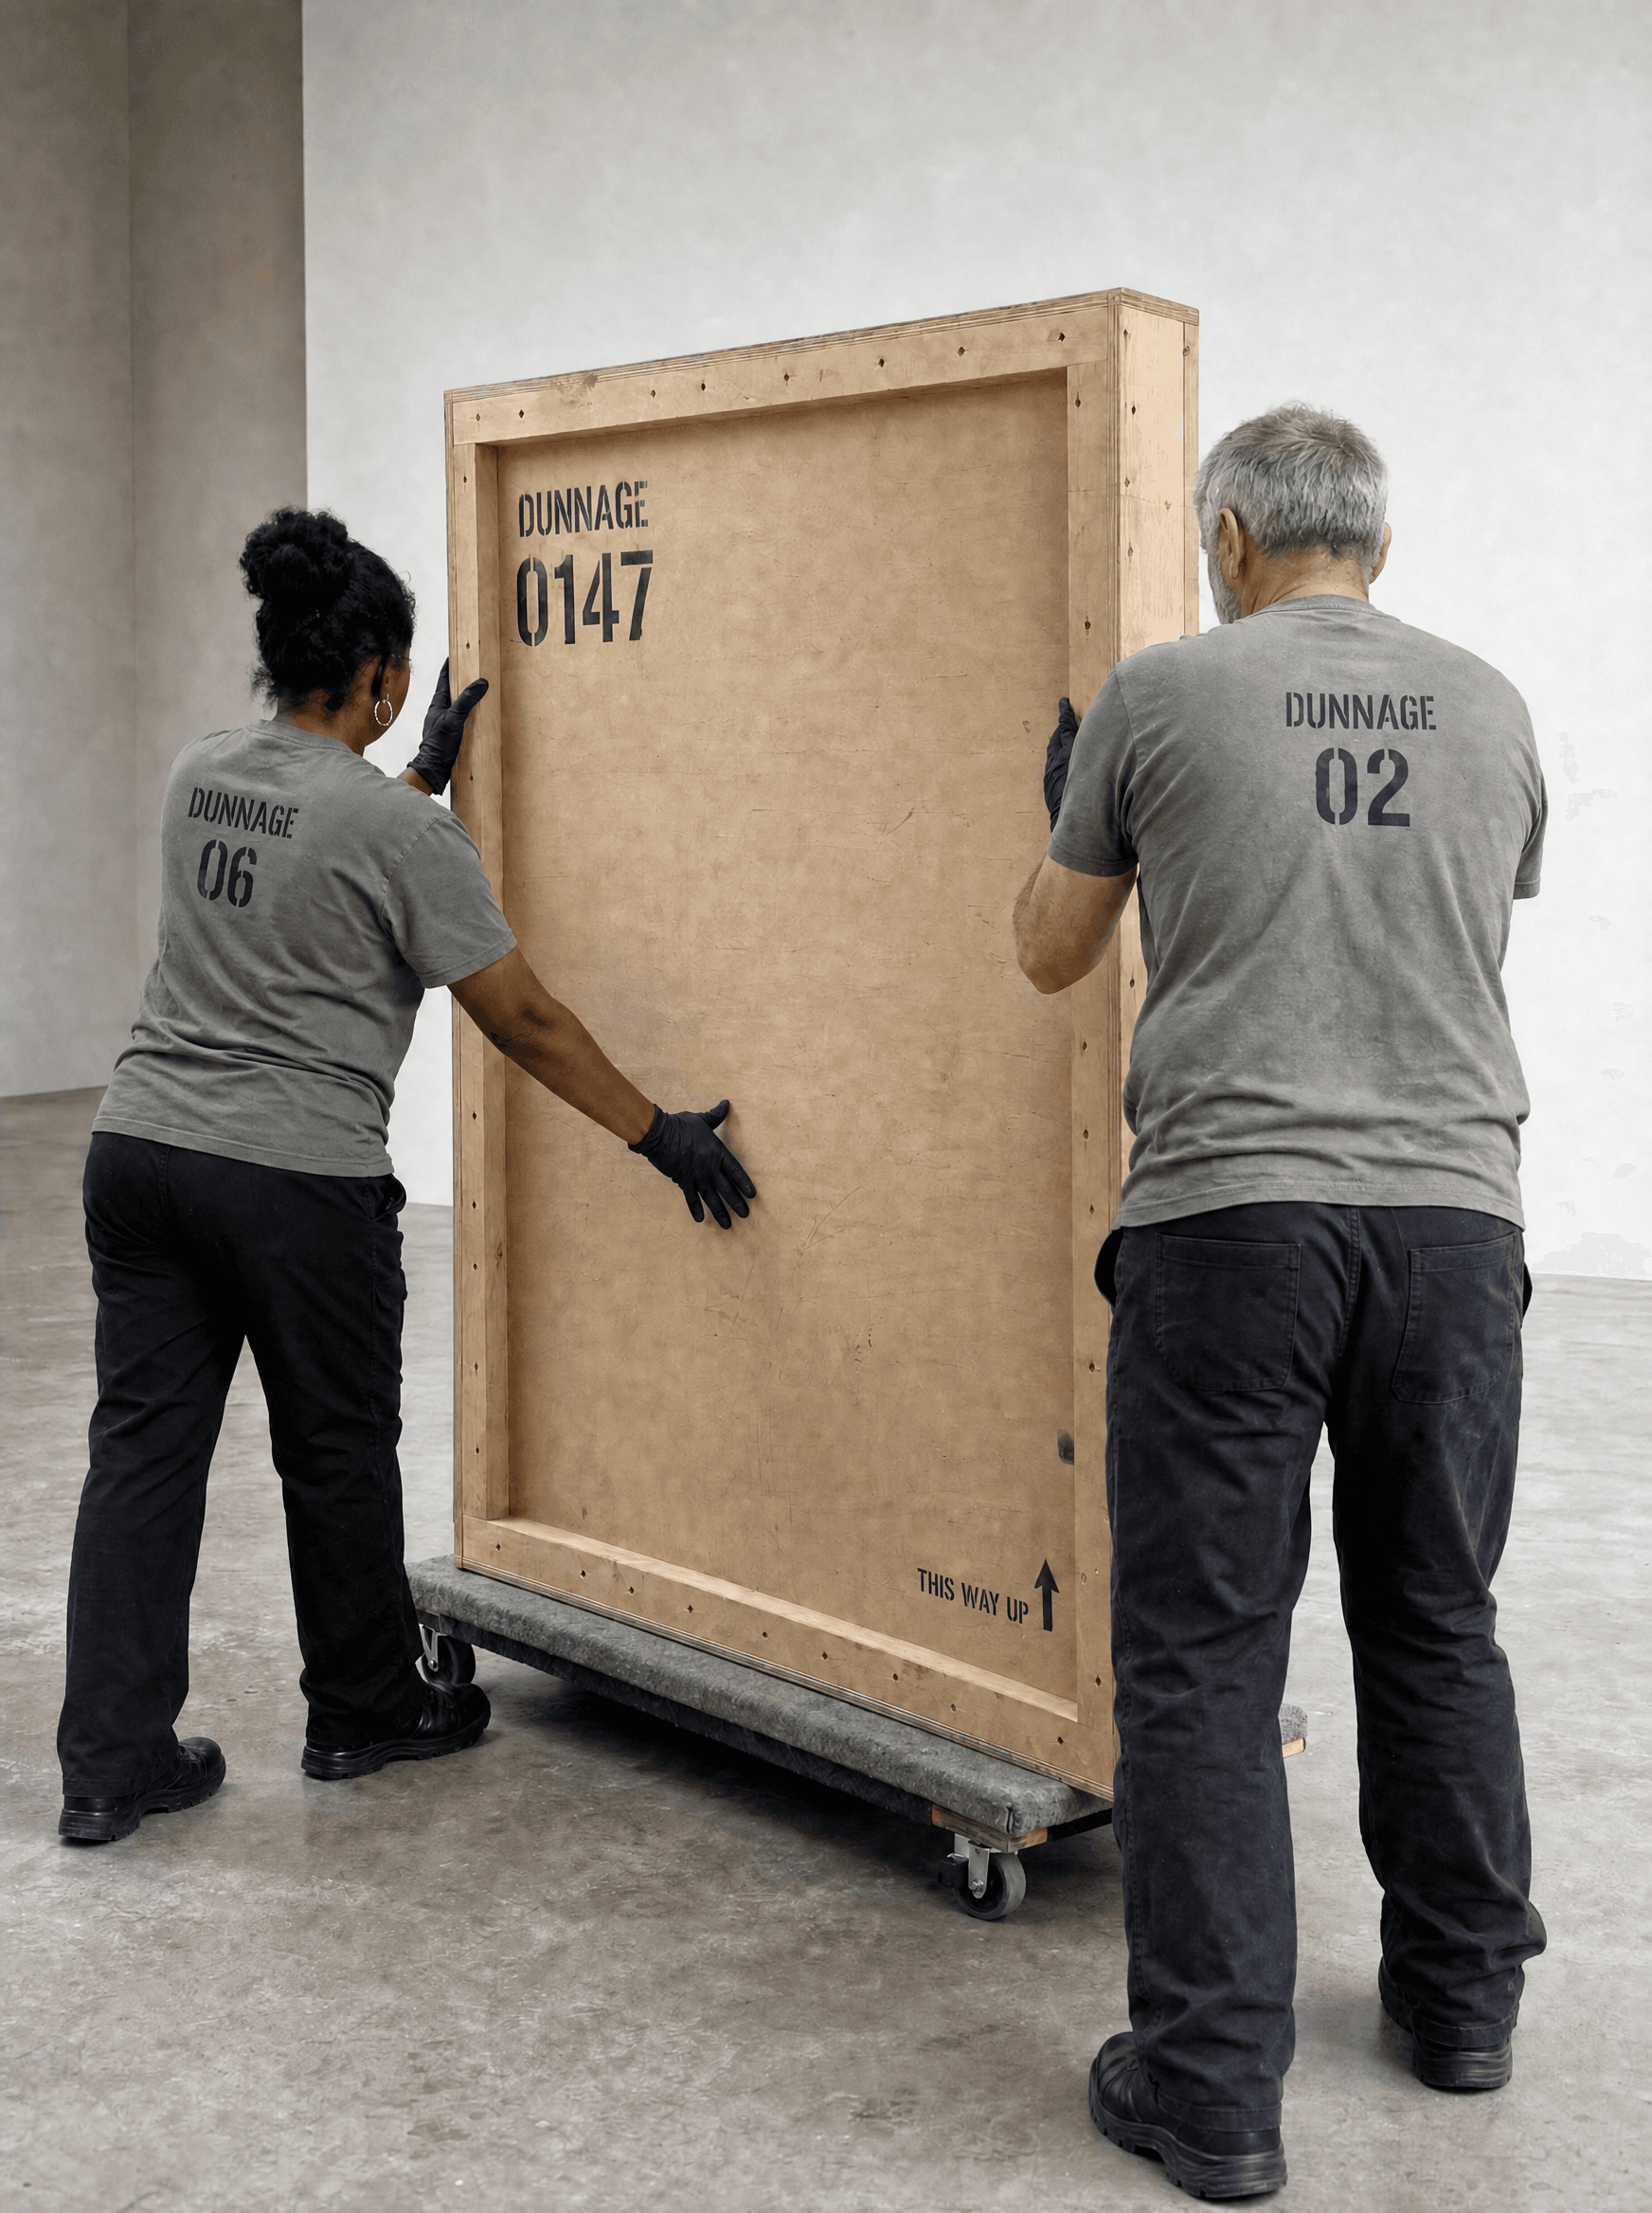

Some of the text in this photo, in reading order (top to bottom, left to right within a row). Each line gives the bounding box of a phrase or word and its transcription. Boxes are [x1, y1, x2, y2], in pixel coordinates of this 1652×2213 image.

[518, 480, 649, 538] DUNNAGE
[516, 549, 654, 647] 0147
[1285, 692, 1437, 730] DUNNAGE
[188, 786, 299, 839] DUNNAGE
[1315, 747, 1410, 827] 02
[197, 838, 258, 908] 06
[917, 1567, 1029, 1625] THIS WAY UP
